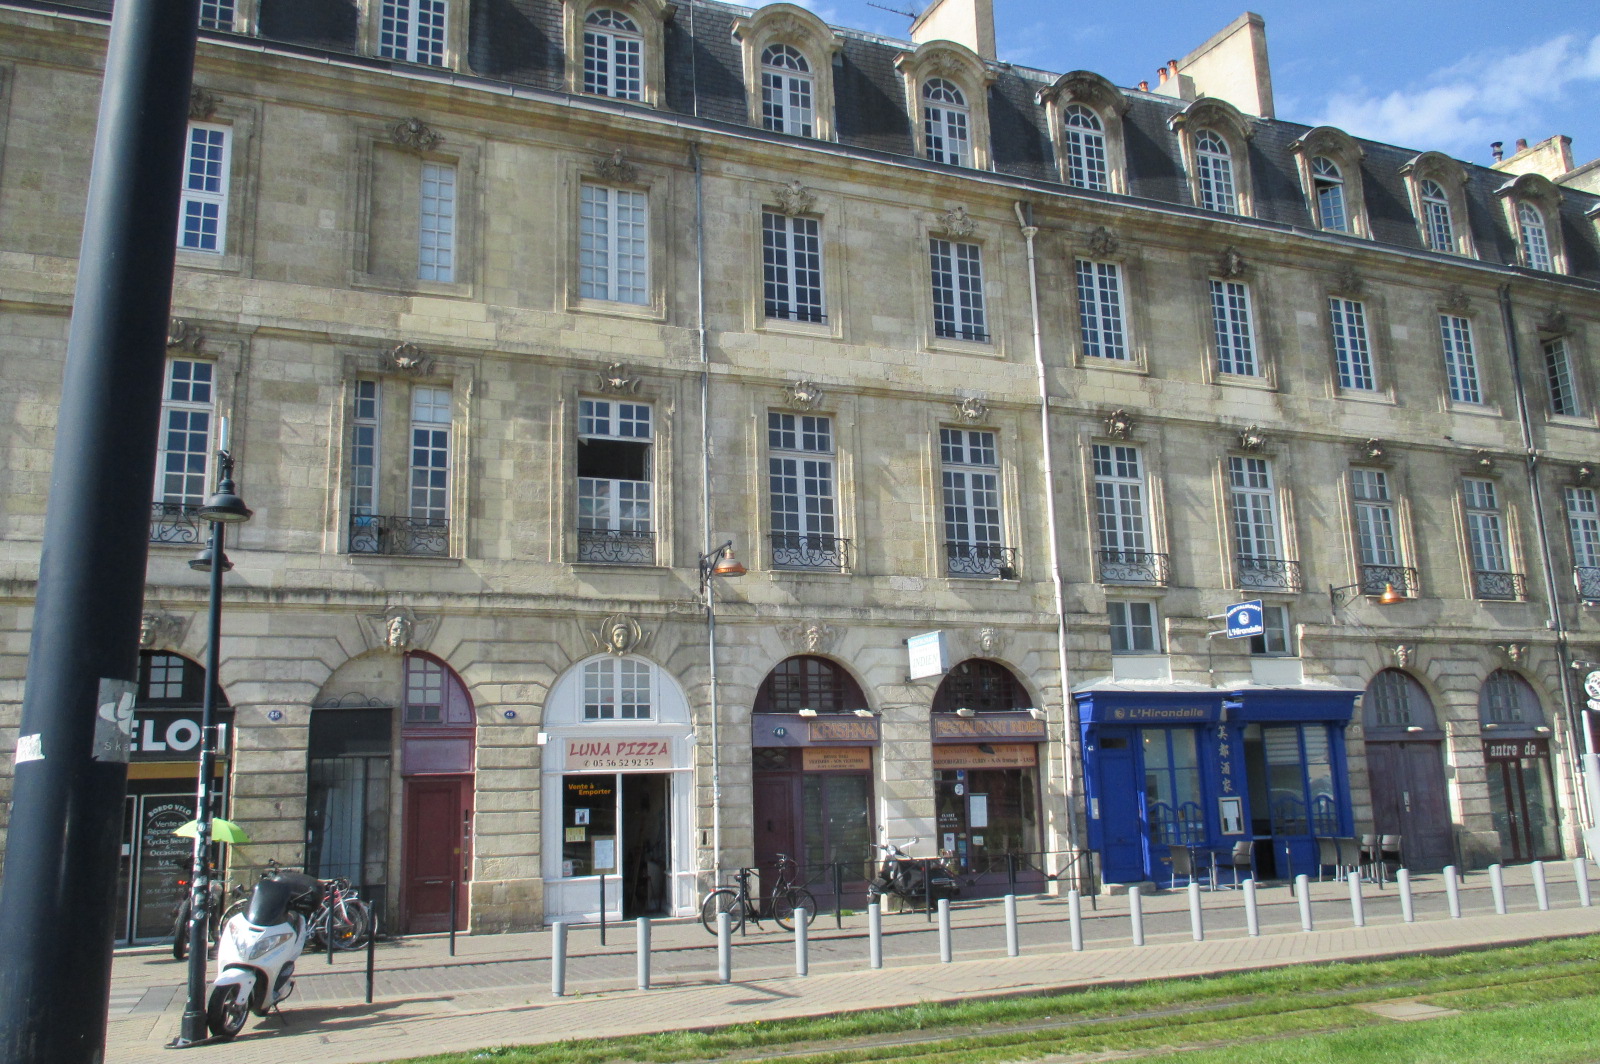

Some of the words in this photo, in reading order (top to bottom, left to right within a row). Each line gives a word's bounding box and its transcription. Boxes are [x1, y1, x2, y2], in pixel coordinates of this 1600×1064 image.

[1229, 625, 1262, 636] L'Hirondelle
[913, 654, 938, 668] INDIEN
[270, 711, 280, 719] 46
[1129, 708, 1204, 718] L'Hirondelle
[811, 722, 878, 739] KRISHNA
[937, 720, 1007, 734] RESTAURANT
[1010, 720, 1045, 733] INDIEN
[569, 742, 611, 757] LUNA
[615, 742, 668, 756] PIZZA
[1525, 741, 1536, 756] de
[593, 759, 603, 767] 05
[605, 759, 616, 767] 56
[618, 759, 629, 767] 52
[578, 788, 611, 796] Emporter
[148, 804, 173, 819] BORDO
[174, 804, 192, 816] VELO
[147, 837, 169, 847] Cycles
